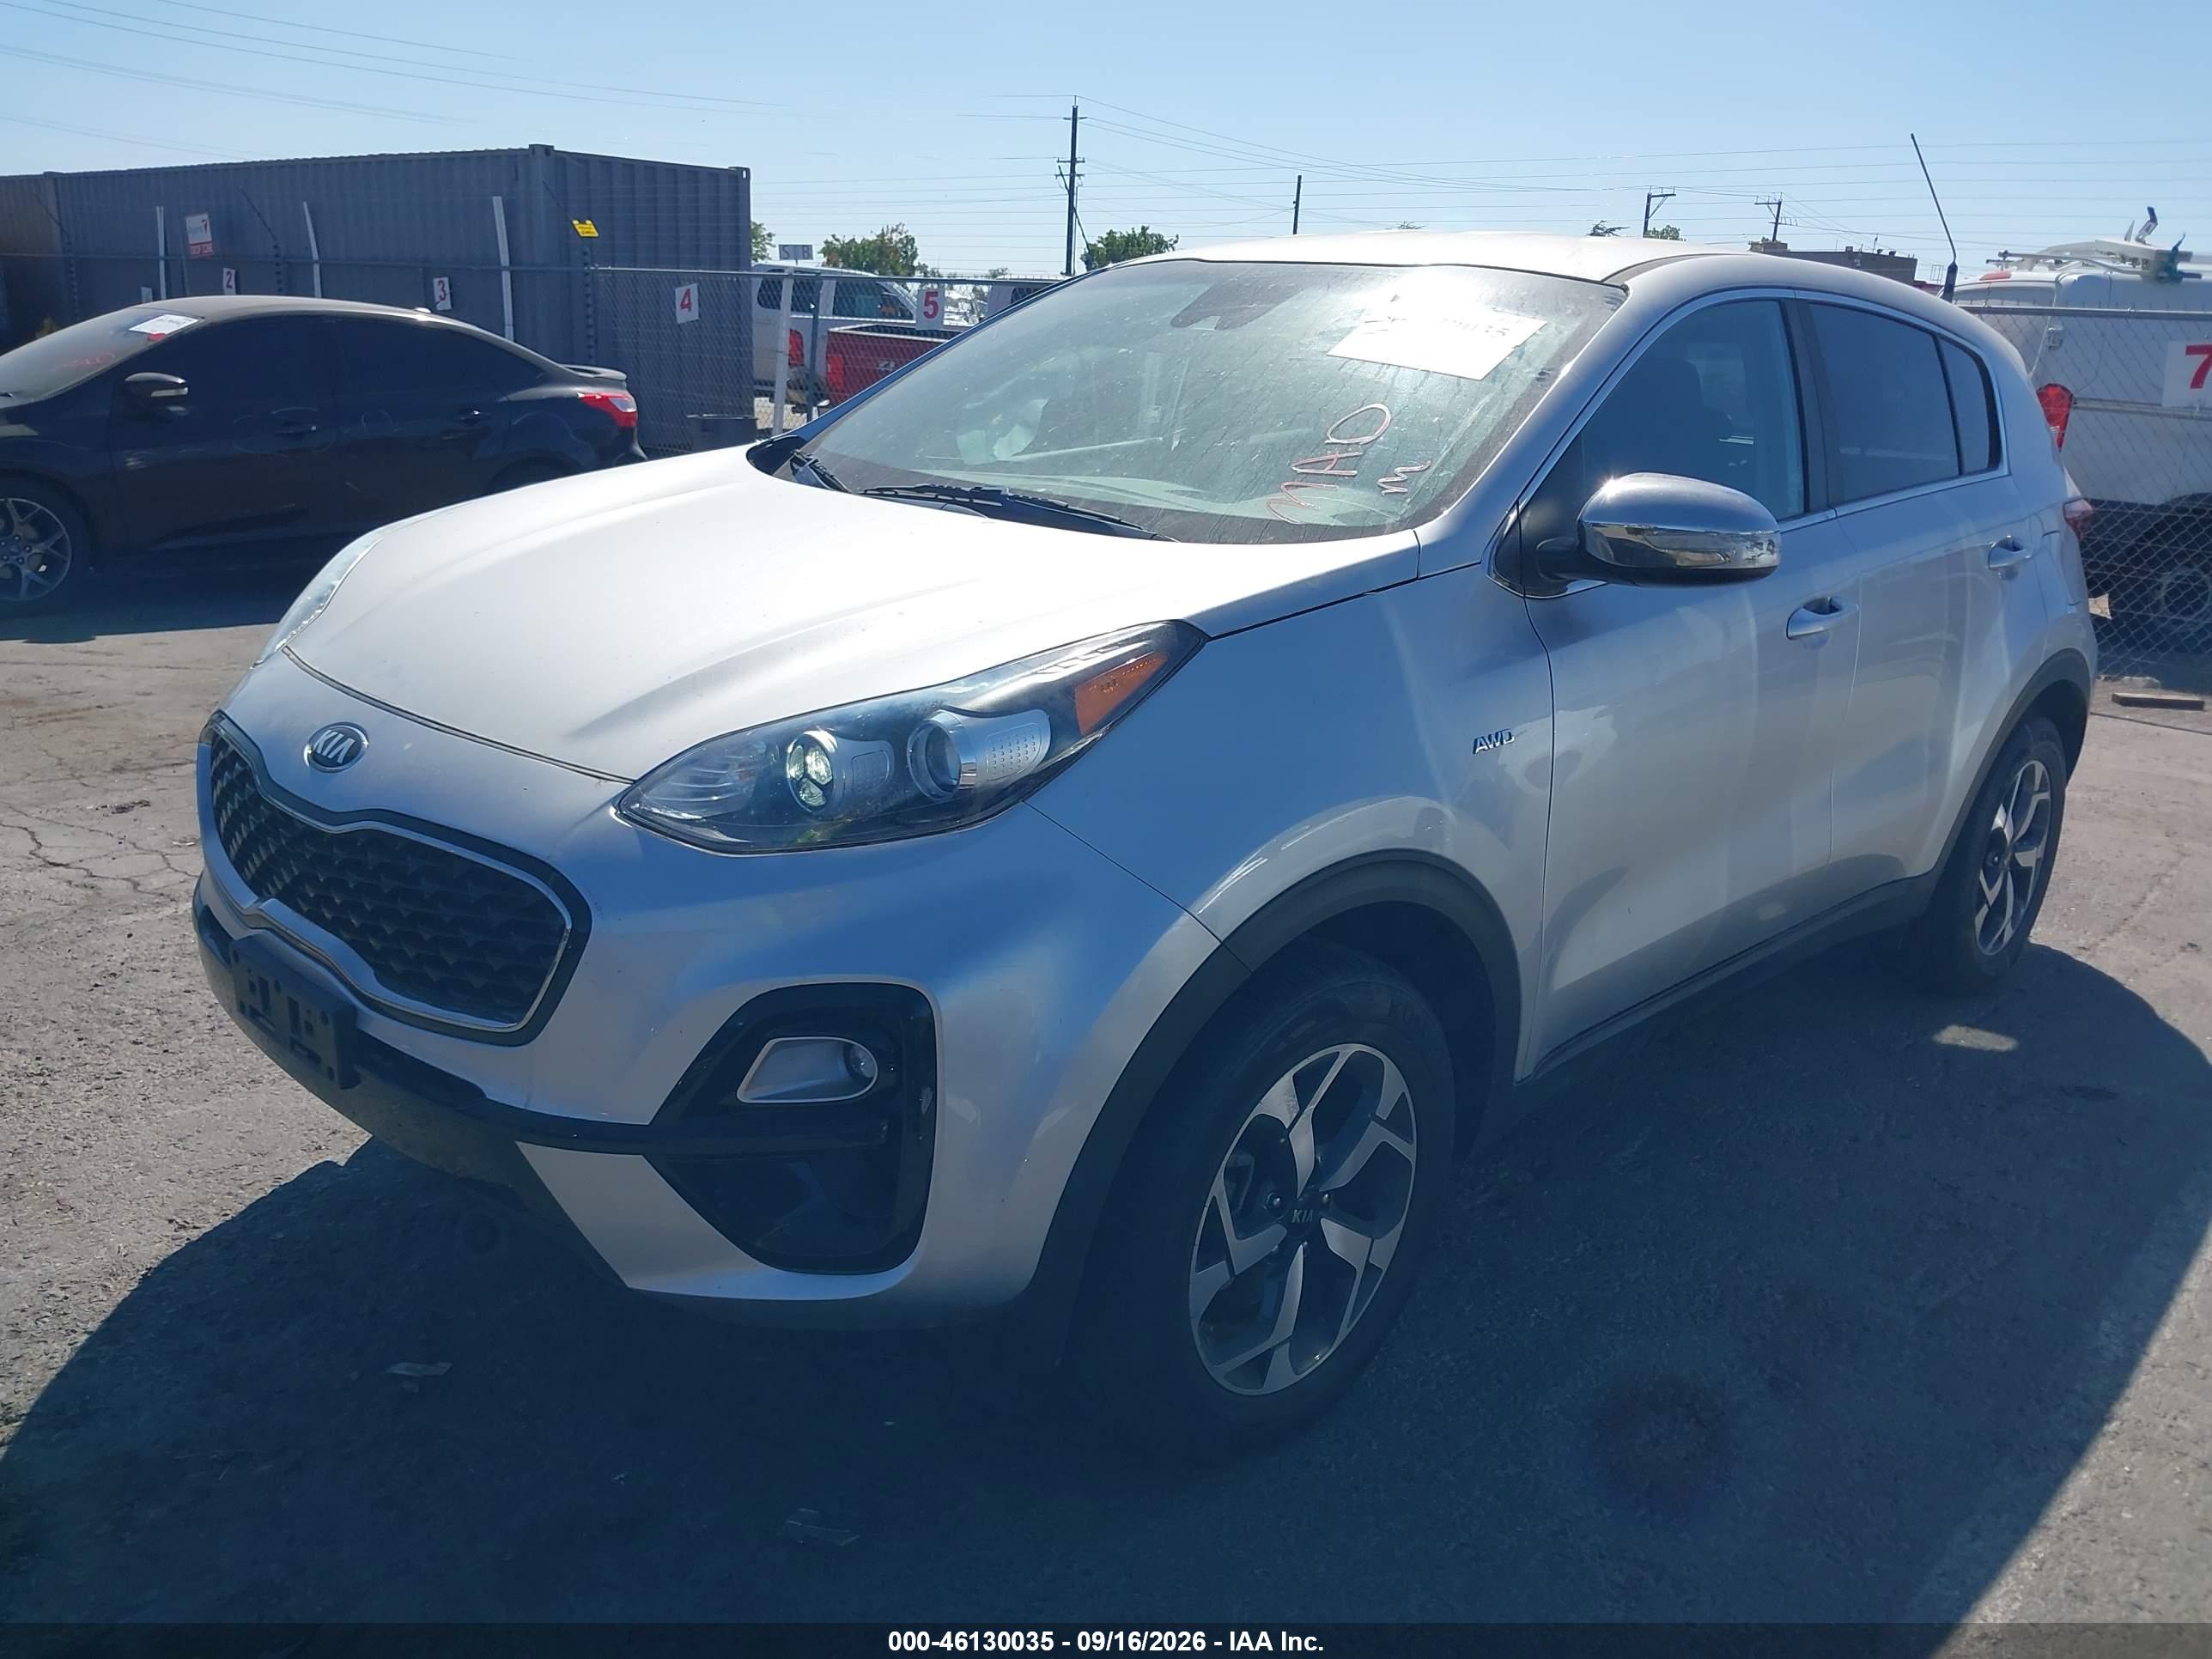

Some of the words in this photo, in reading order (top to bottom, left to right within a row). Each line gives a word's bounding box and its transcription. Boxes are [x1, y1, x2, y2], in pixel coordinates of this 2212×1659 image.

[226, 270, 234, 289] 2
[438, 279, 447, 301] 3
[680, 288, 691, 312] 4
[923, 291, 939, 319] 5
[2185, 344, 2212, 389] 7
[313, 729, 356, 764] KIA
[1473, 728, 1515, 755] AWD
[1291, 1209, 1314, 1224] KIA
